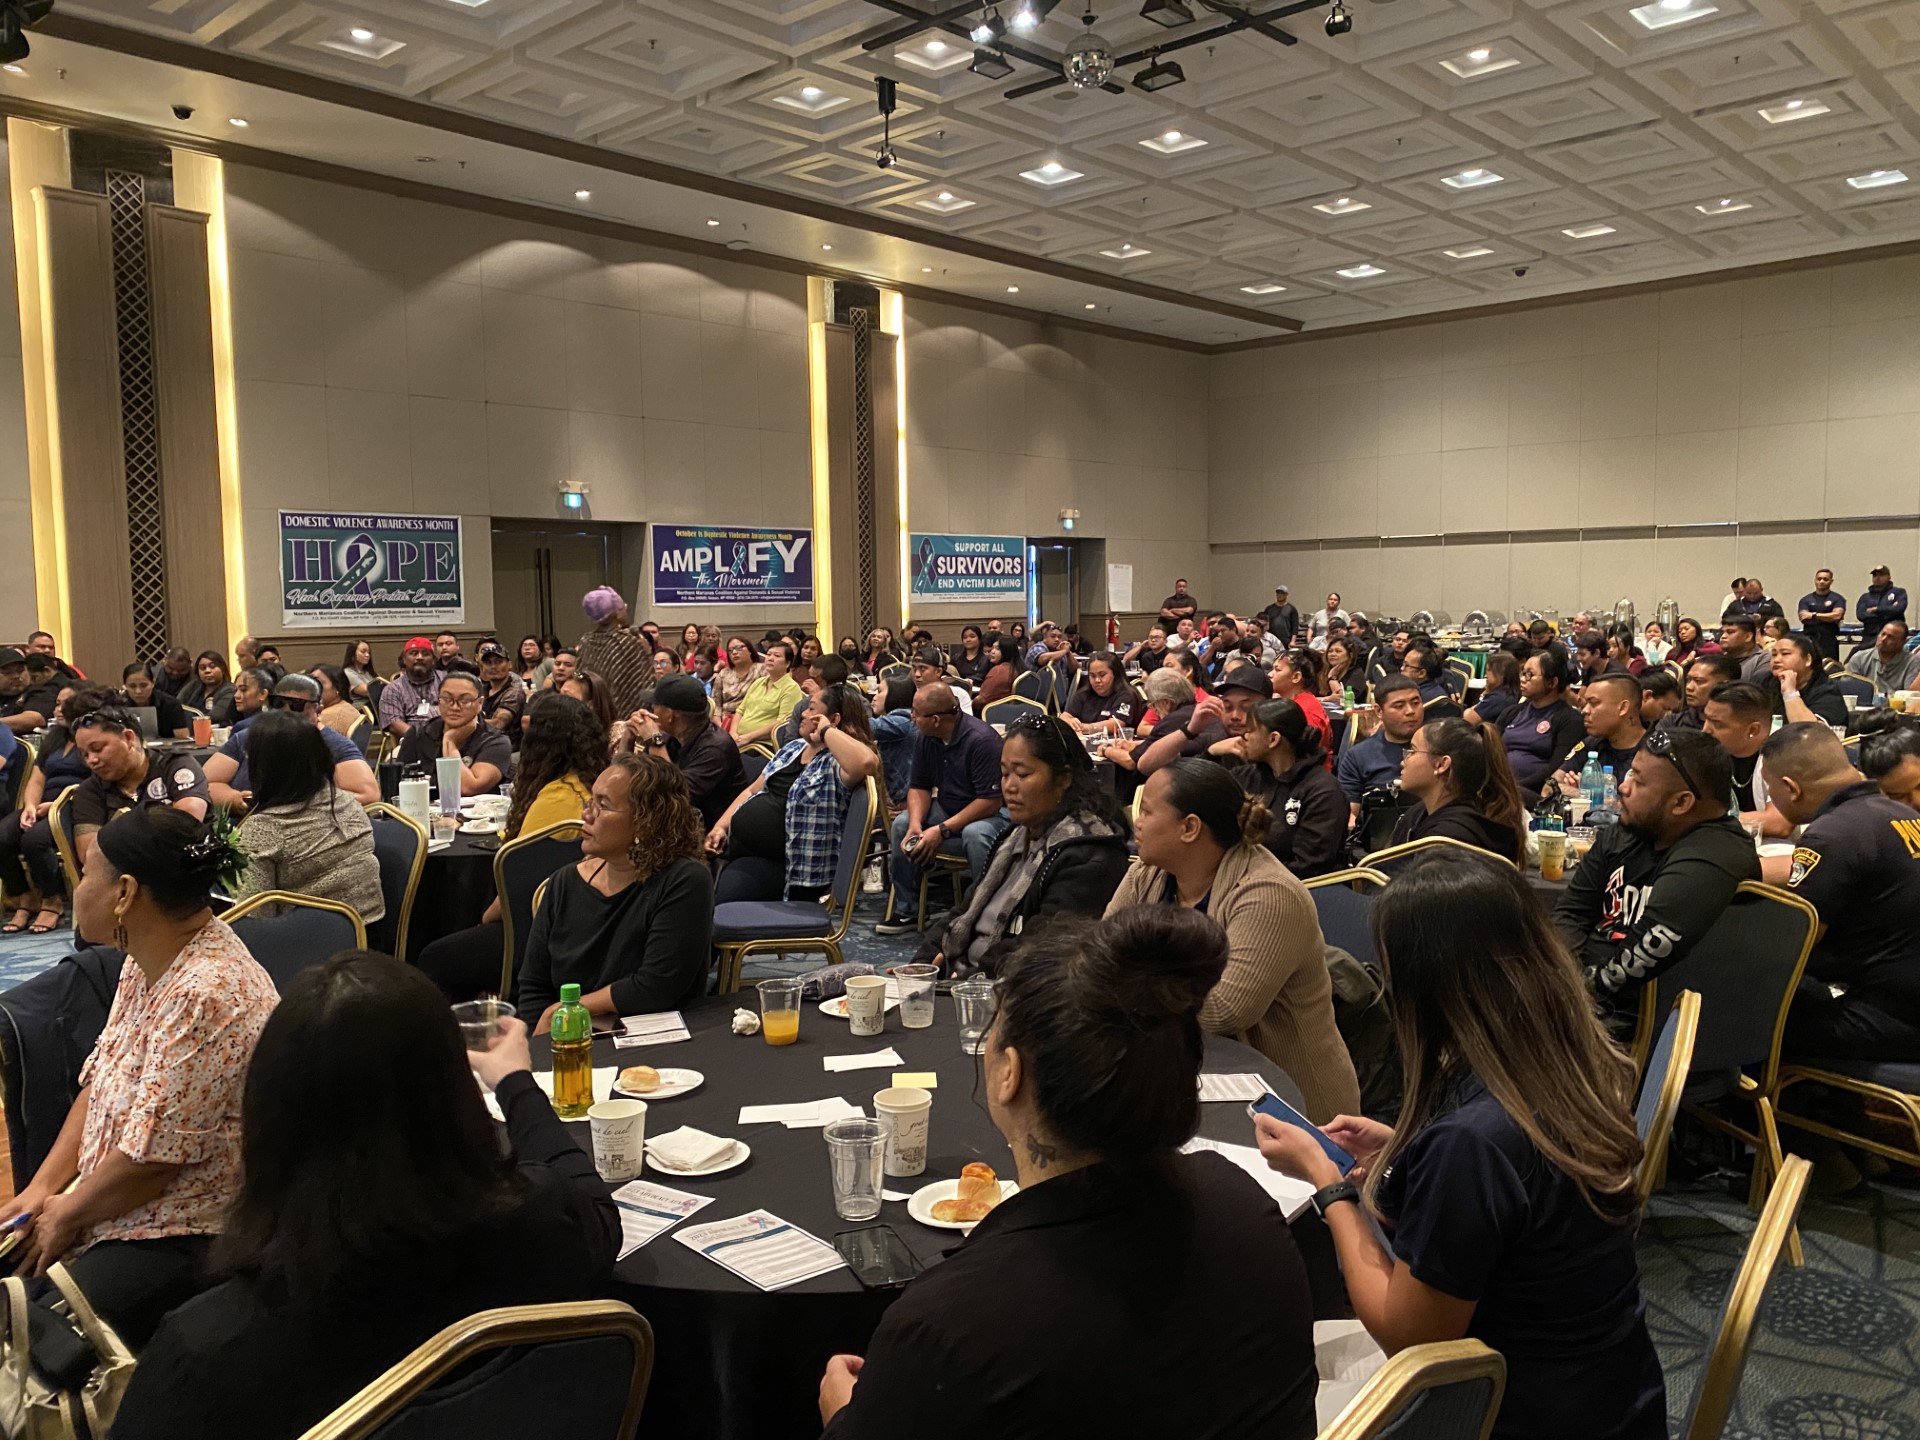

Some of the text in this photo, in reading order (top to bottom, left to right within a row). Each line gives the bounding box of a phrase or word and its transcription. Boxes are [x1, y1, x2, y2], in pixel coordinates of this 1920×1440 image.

[285, 515, 454, 530] DOMESTIC VIOLENCE AWARENESS MONTH
[675, 529, 697, 537] October
[729, 531, 750, 539] Violence
[954, 542, 1005, 553] SUPPORT ALL
[937, 556, 1021, 575] SURVIVORS
[692, 571, 778, 588] the Movement
[938, 579, 1021, 589] END VICTIM BLAMING
